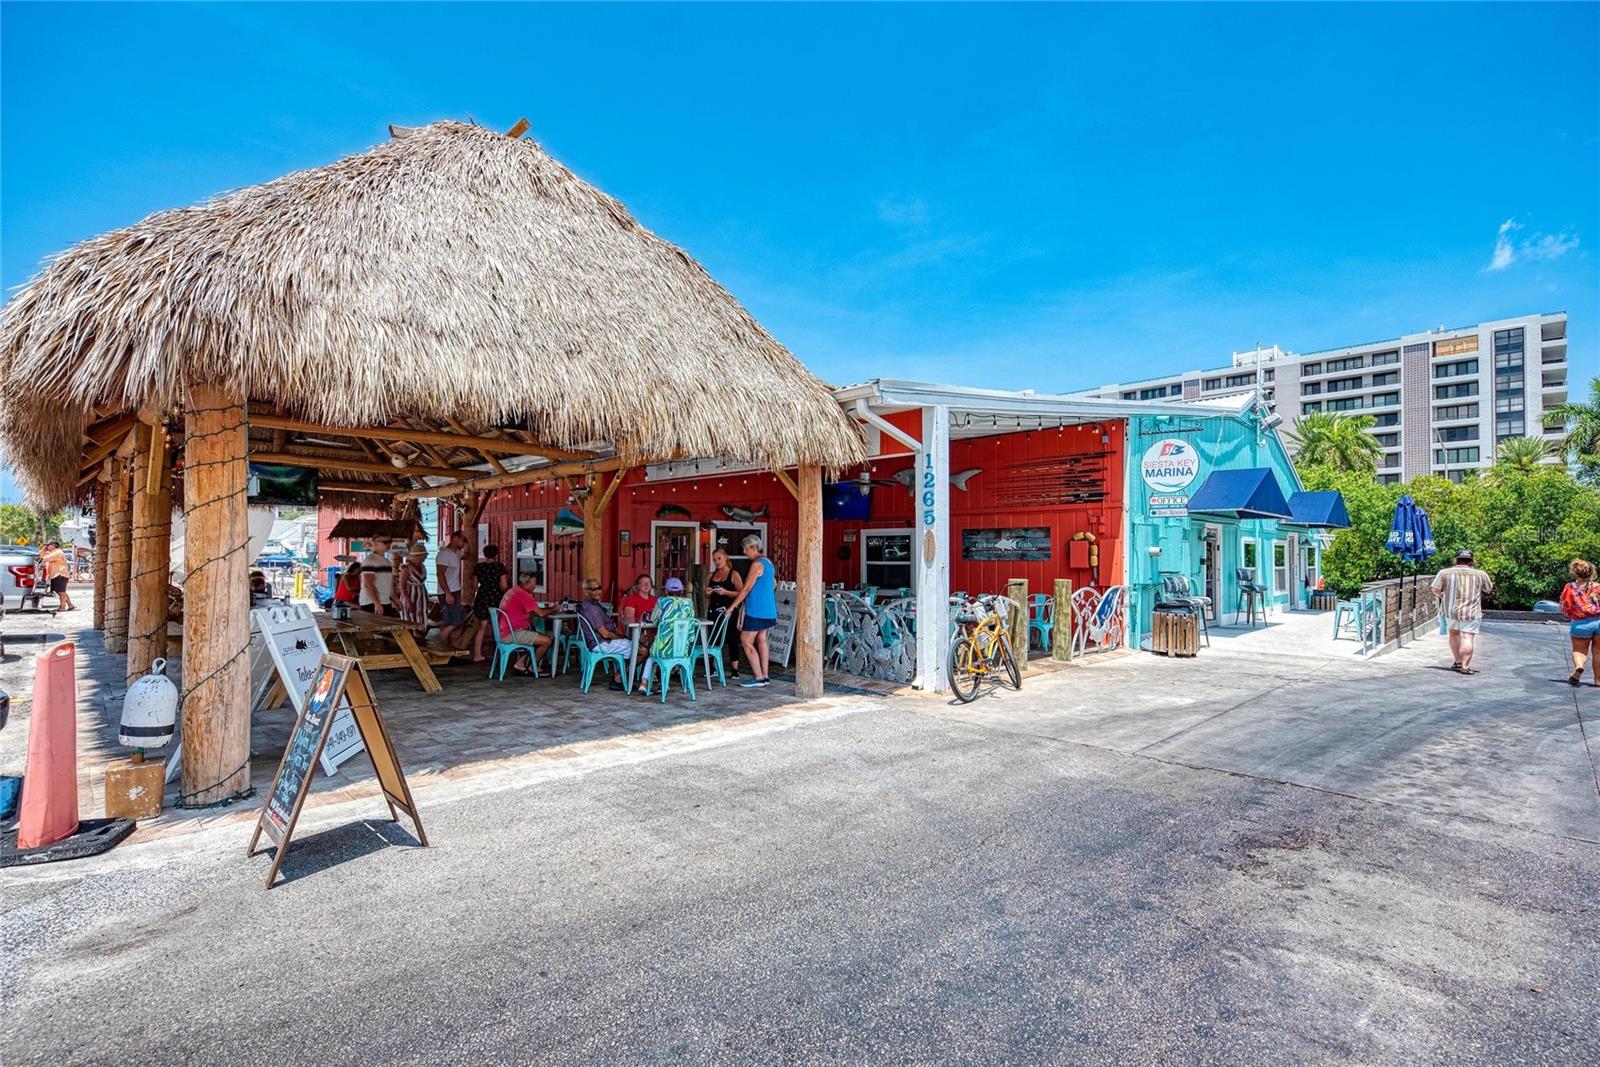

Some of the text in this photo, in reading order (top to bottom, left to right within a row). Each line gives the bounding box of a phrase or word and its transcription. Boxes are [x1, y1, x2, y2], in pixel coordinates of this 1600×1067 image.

[1143, 459, 1195, 469] SIESTA KEY
[1145, 467, 1193, 478] MARINA
[923, 453, 935, 525] 1265
